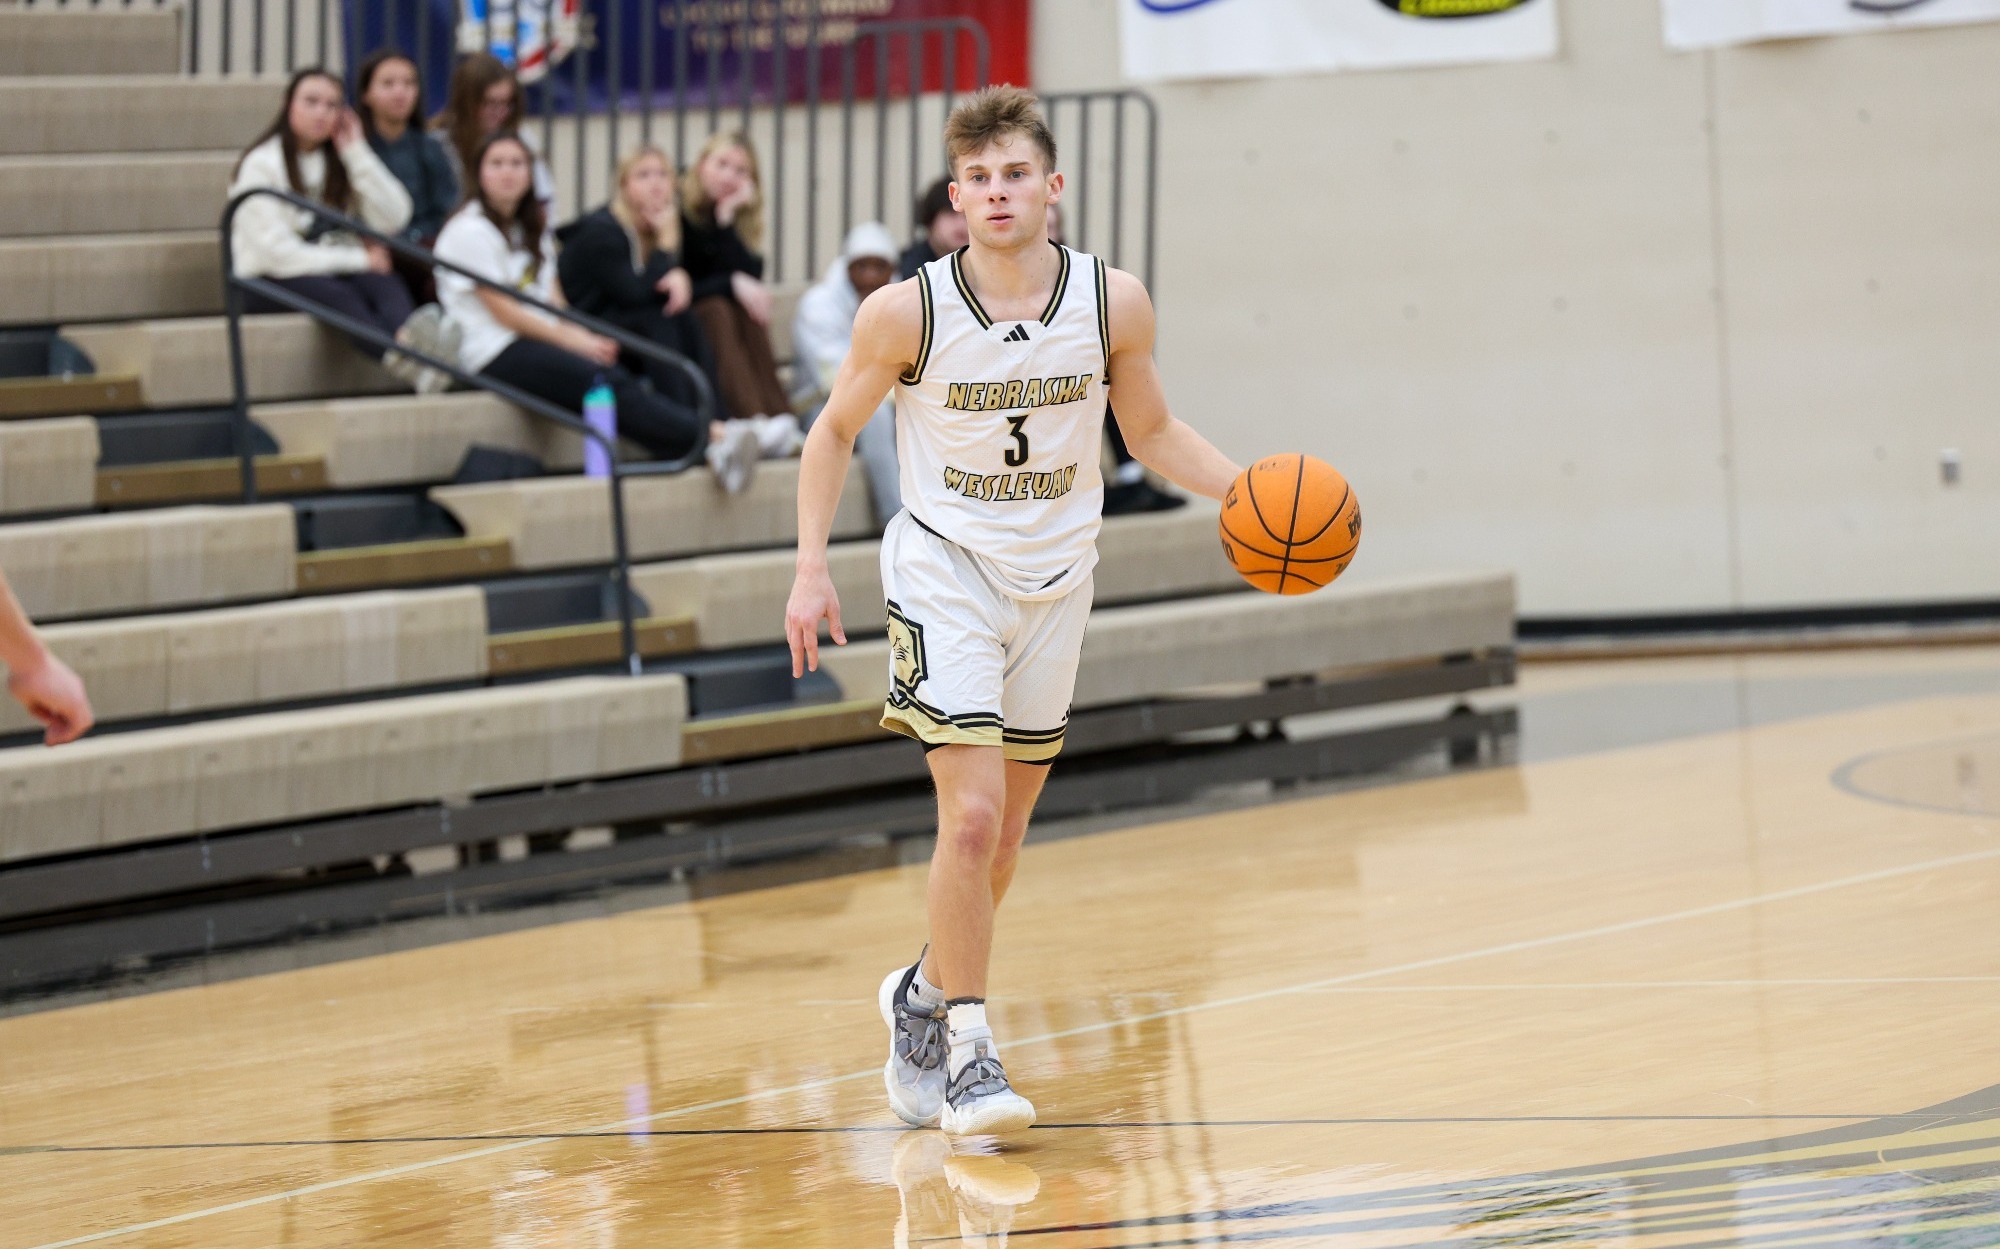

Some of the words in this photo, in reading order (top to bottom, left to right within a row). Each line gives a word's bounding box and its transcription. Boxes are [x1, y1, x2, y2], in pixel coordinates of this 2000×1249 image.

[944, 374, 1092, 411] NEBRASKA
[1004, 413, 1031, 467] 3
[944, 463, 1077, 501] WESLEYAN
